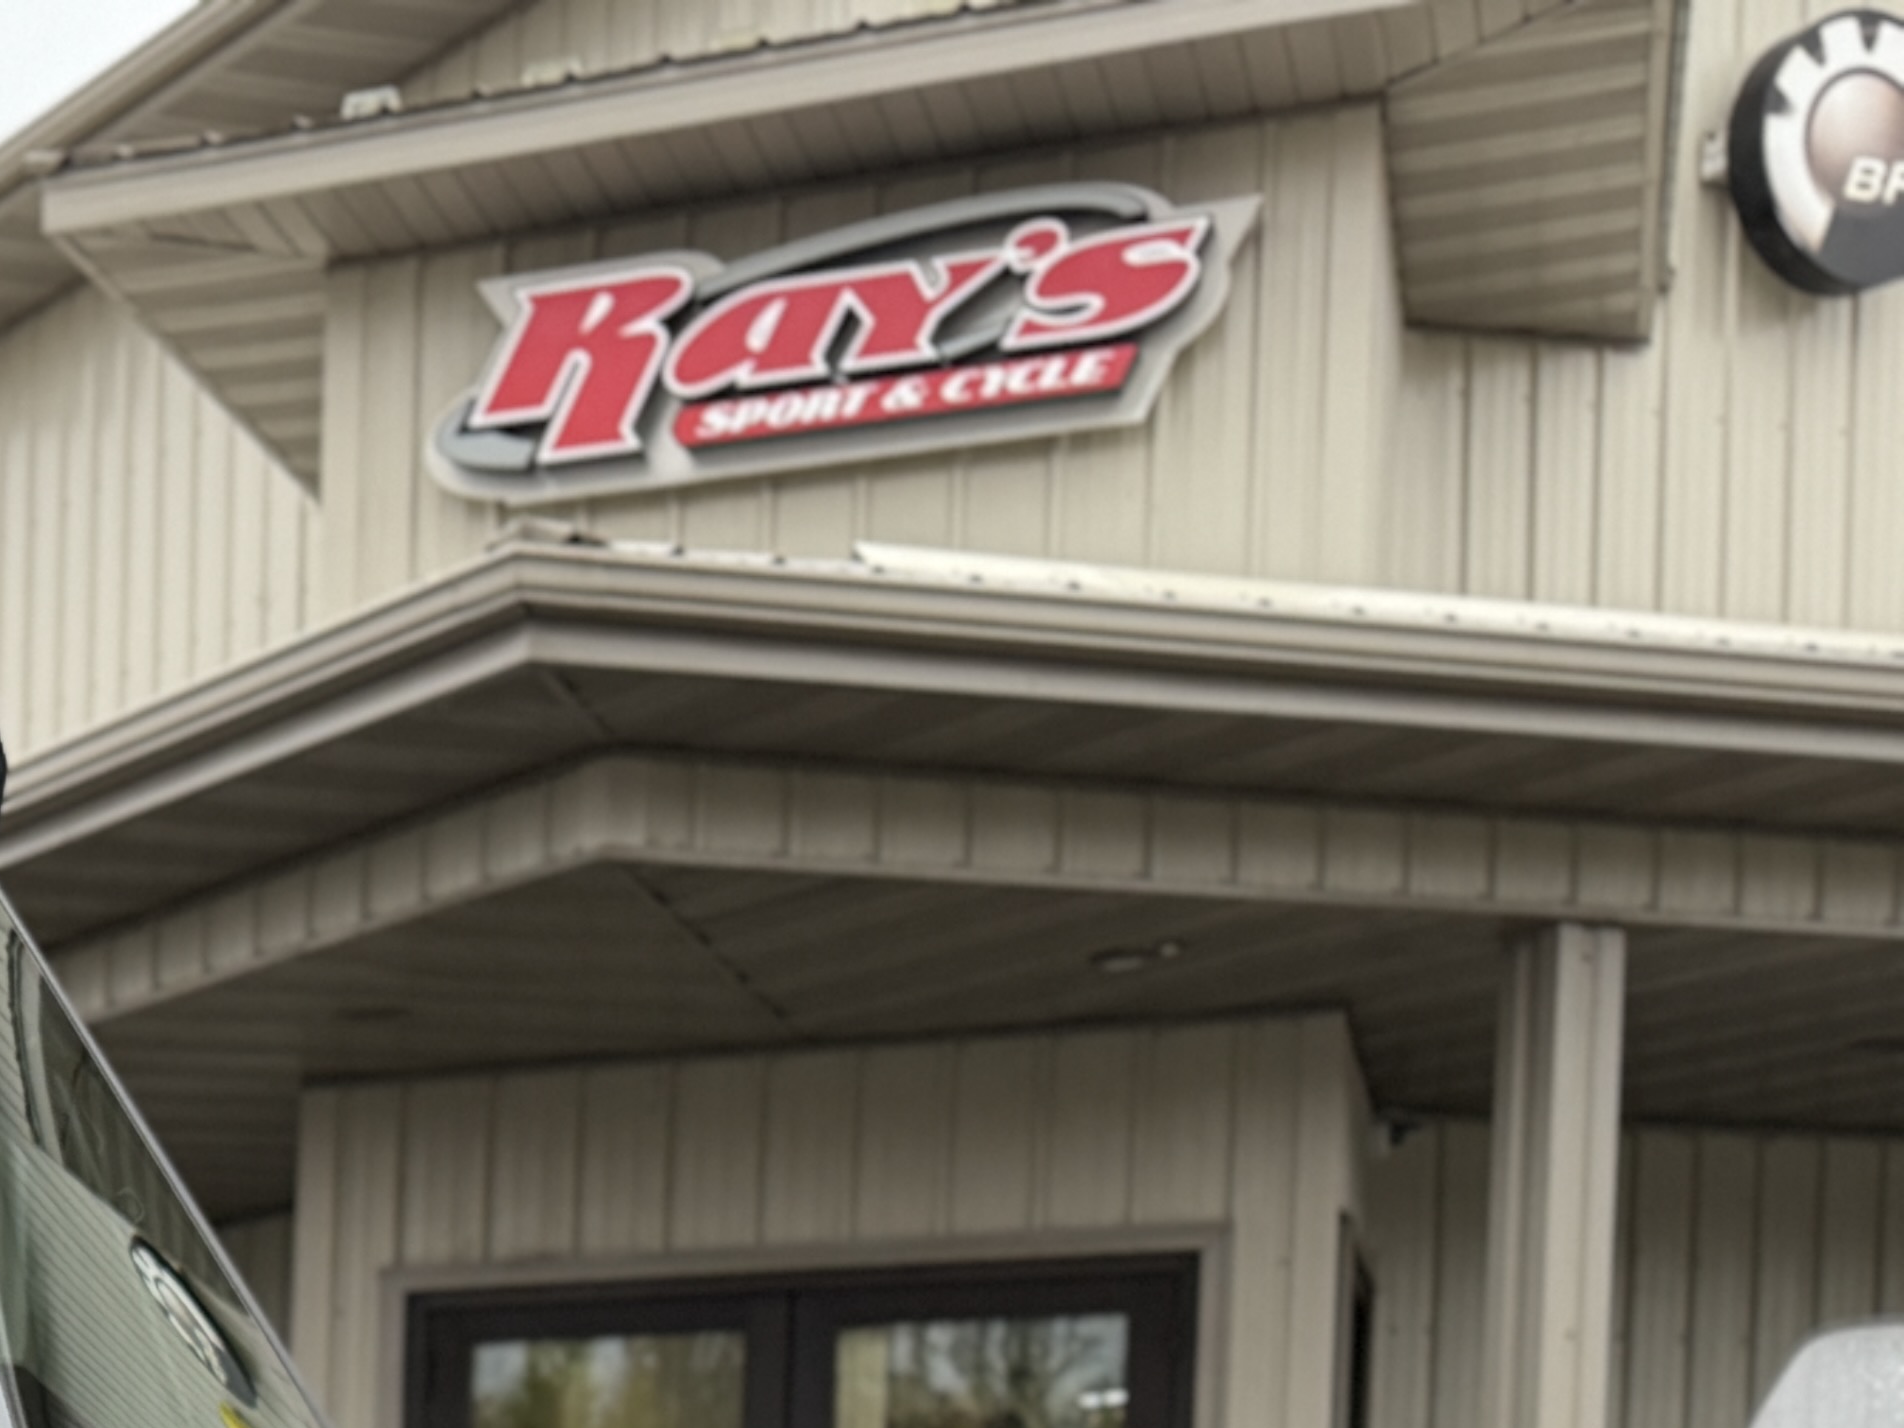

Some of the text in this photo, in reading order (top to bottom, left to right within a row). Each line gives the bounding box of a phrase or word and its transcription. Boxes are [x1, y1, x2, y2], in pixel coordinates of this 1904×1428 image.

[694, 350, 1115, 440] SPORT & CYCLE
